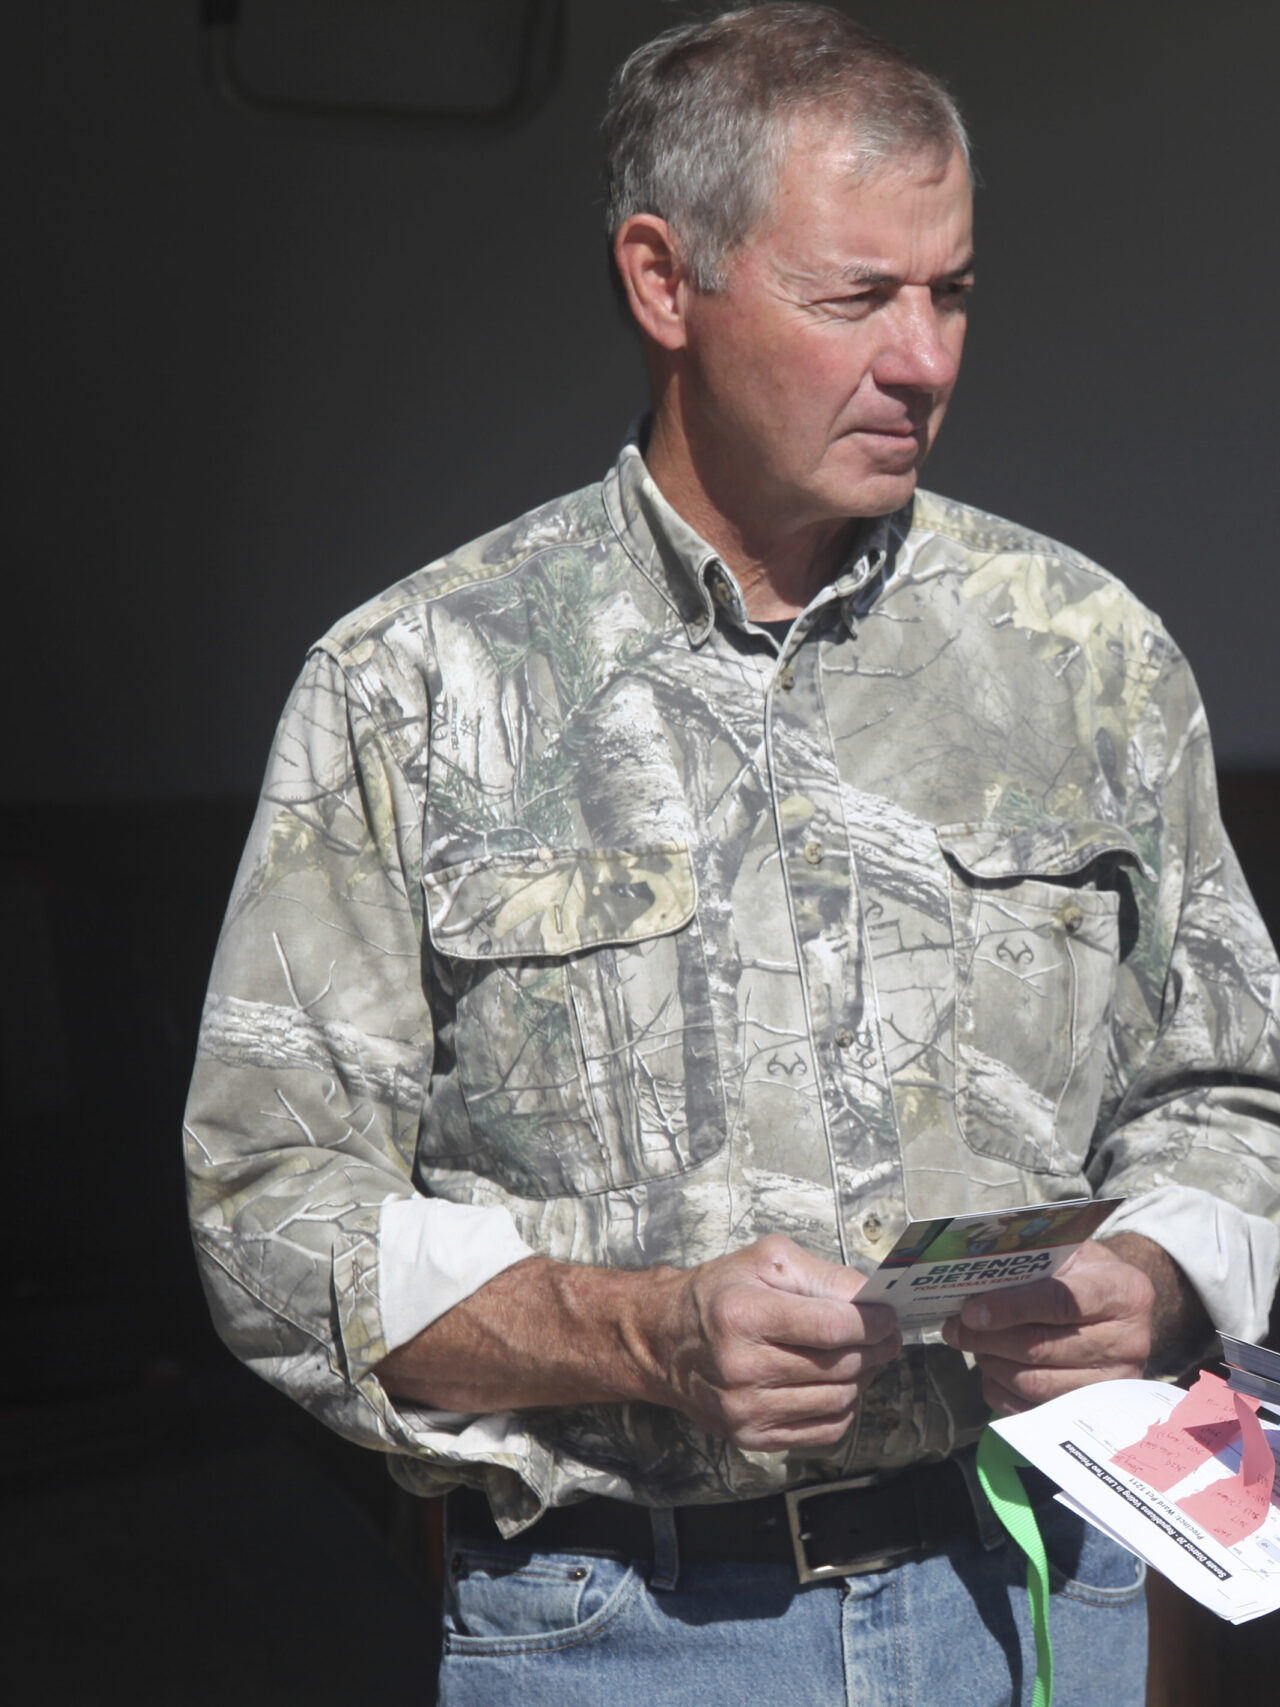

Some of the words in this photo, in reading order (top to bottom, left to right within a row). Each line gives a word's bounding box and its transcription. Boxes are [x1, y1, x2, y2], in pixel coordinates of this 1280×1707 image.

[928, 1252, 1050, 1276] BRENDA
[911, 1261, 1053, 1286] DIETRICH
[1064, 1443, 1093, 1467] Primaries
[1091, 1465, 1105, 1478] Two
[1102, 1475, 1119, 1488] Last
[1129, 1478, 1146, 1491] 1211
[1121, 1490, 1142, 1507] Voting
[1145, 1490, 1158, 1501] Pct
[1156, 1501, 1175, 1516] Ward
[1140, 1505, 1177, 1536] Republicans
[1174, 1514, 1204, 1540] Precinct:
[1176, 1537, 1188, 1545] 20
[1184, 1543, 1208, 1562] District
[1205, 1560, 1227, 1578] Senate
